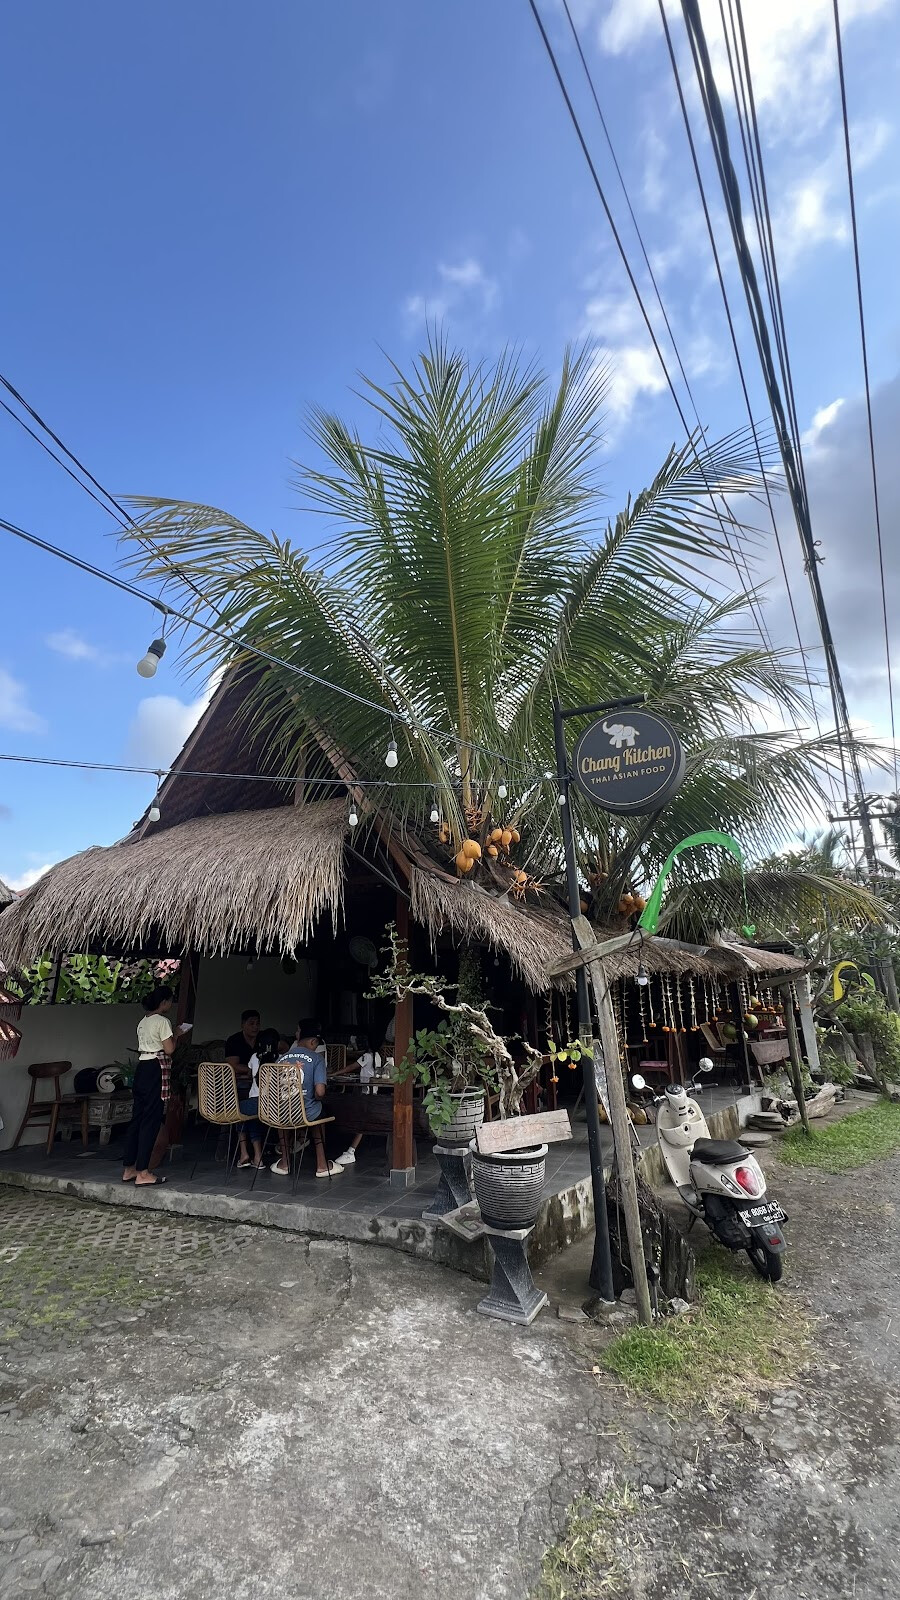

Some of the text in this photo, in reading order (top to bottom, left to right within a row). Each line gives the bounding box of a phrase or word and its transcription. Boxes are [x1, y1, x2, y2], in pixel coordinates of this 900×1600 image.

[581, 745, 672, 774] Chang Kitchen
[591, 765, 666, 785] THAI ASIAN FOOD
